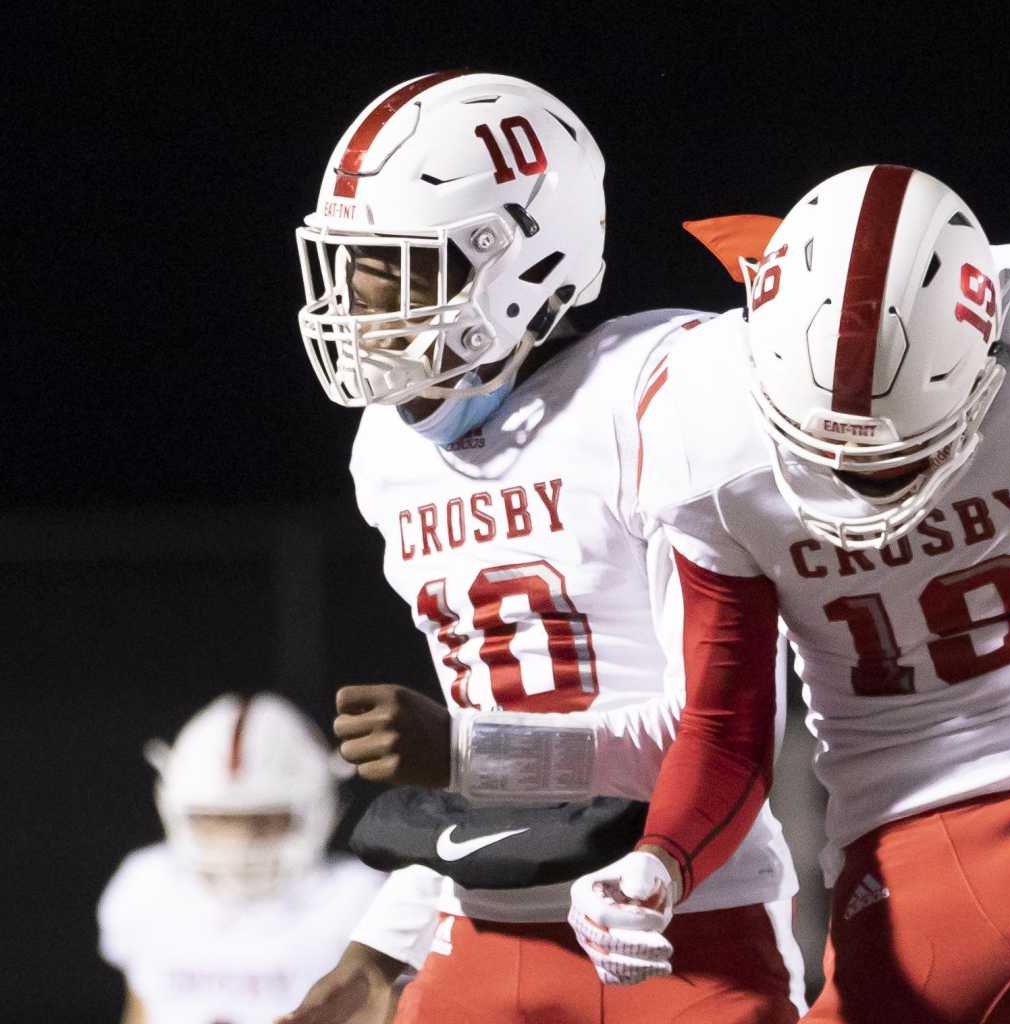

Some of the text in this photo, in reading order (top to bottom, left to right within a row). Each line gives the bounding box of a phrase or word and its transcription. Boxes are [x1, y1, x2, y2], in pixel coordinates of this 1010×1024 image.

[475, 115, 548, 185] 10
[954, 262, 997, 345] 19
[398, 477, 565, 562] CROSBY
[416, 558, 600, 715] 10
